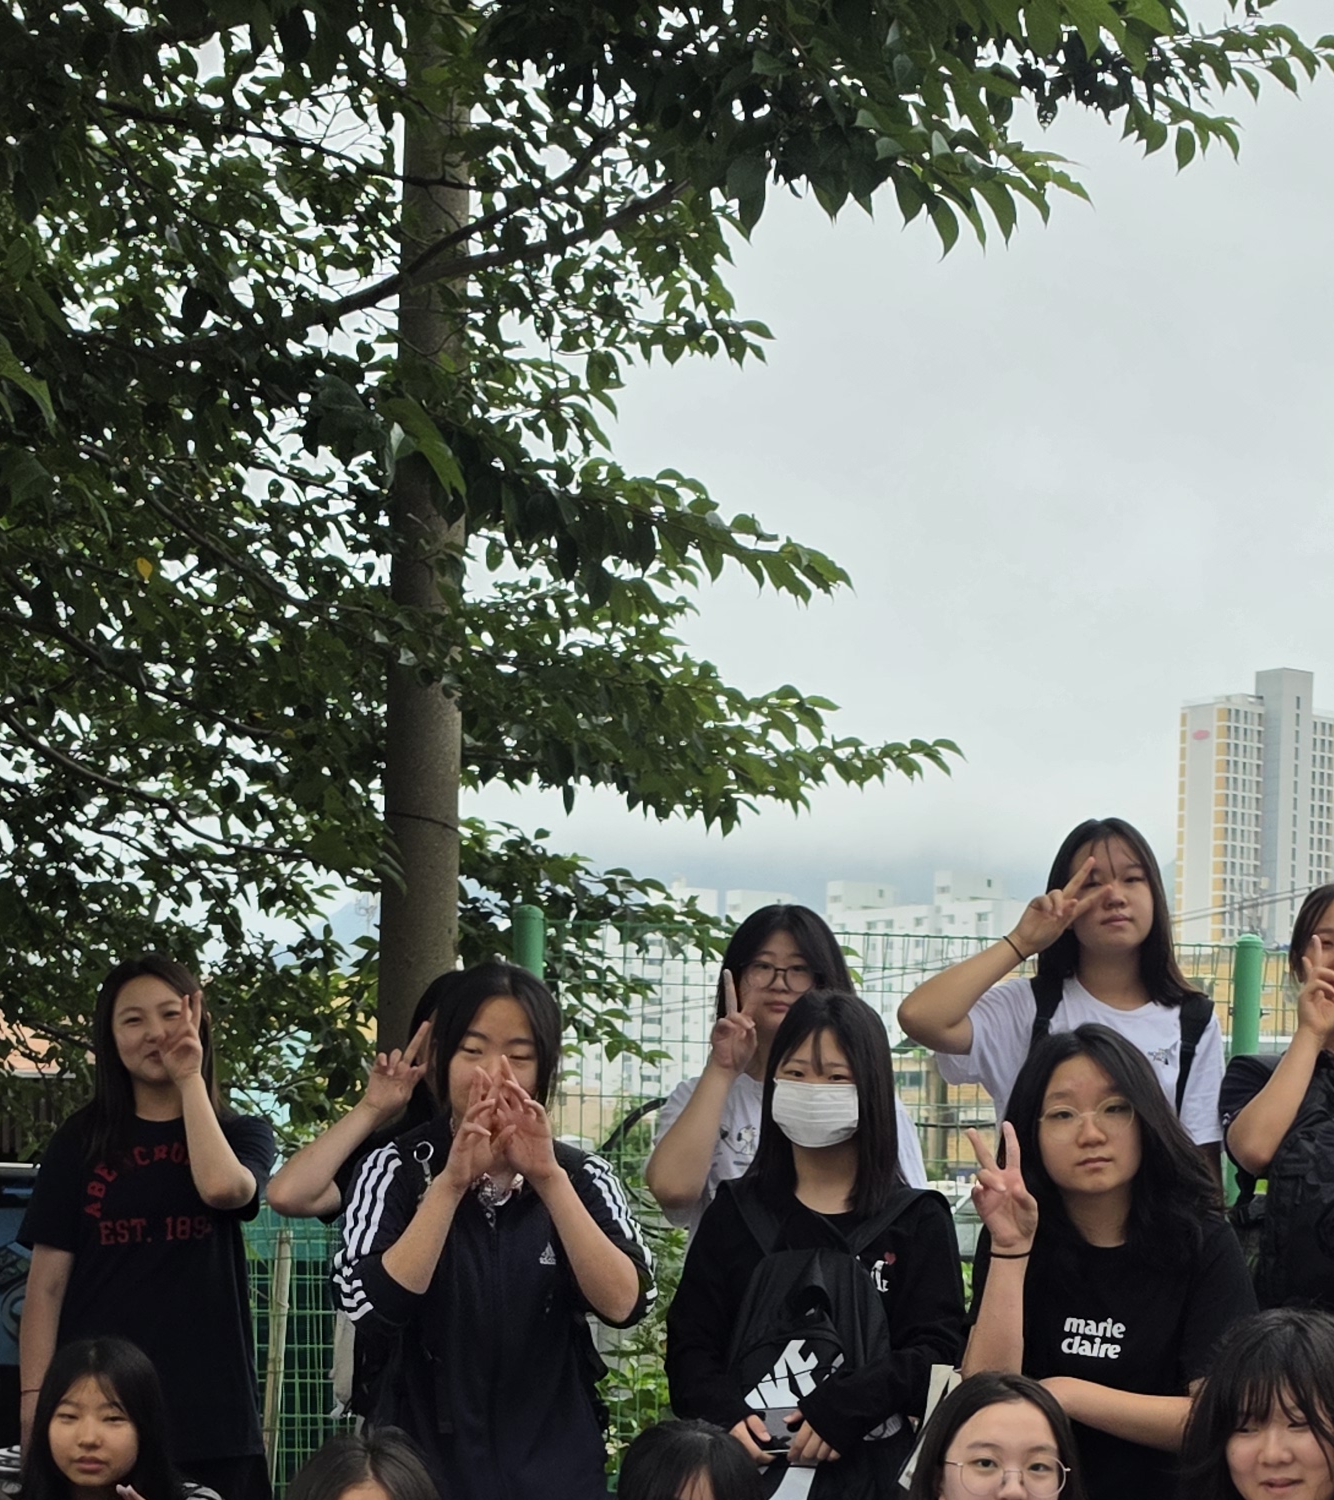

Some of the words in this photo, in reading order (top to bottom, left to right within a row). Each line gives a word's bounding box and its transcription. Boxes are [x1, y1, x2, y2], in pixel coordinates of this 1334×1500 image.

[99, 1217, 152, 1246] EST.
[1064, 1317, 1126, 1338] marie
[1061, 1336, 1121, 1359] claire
